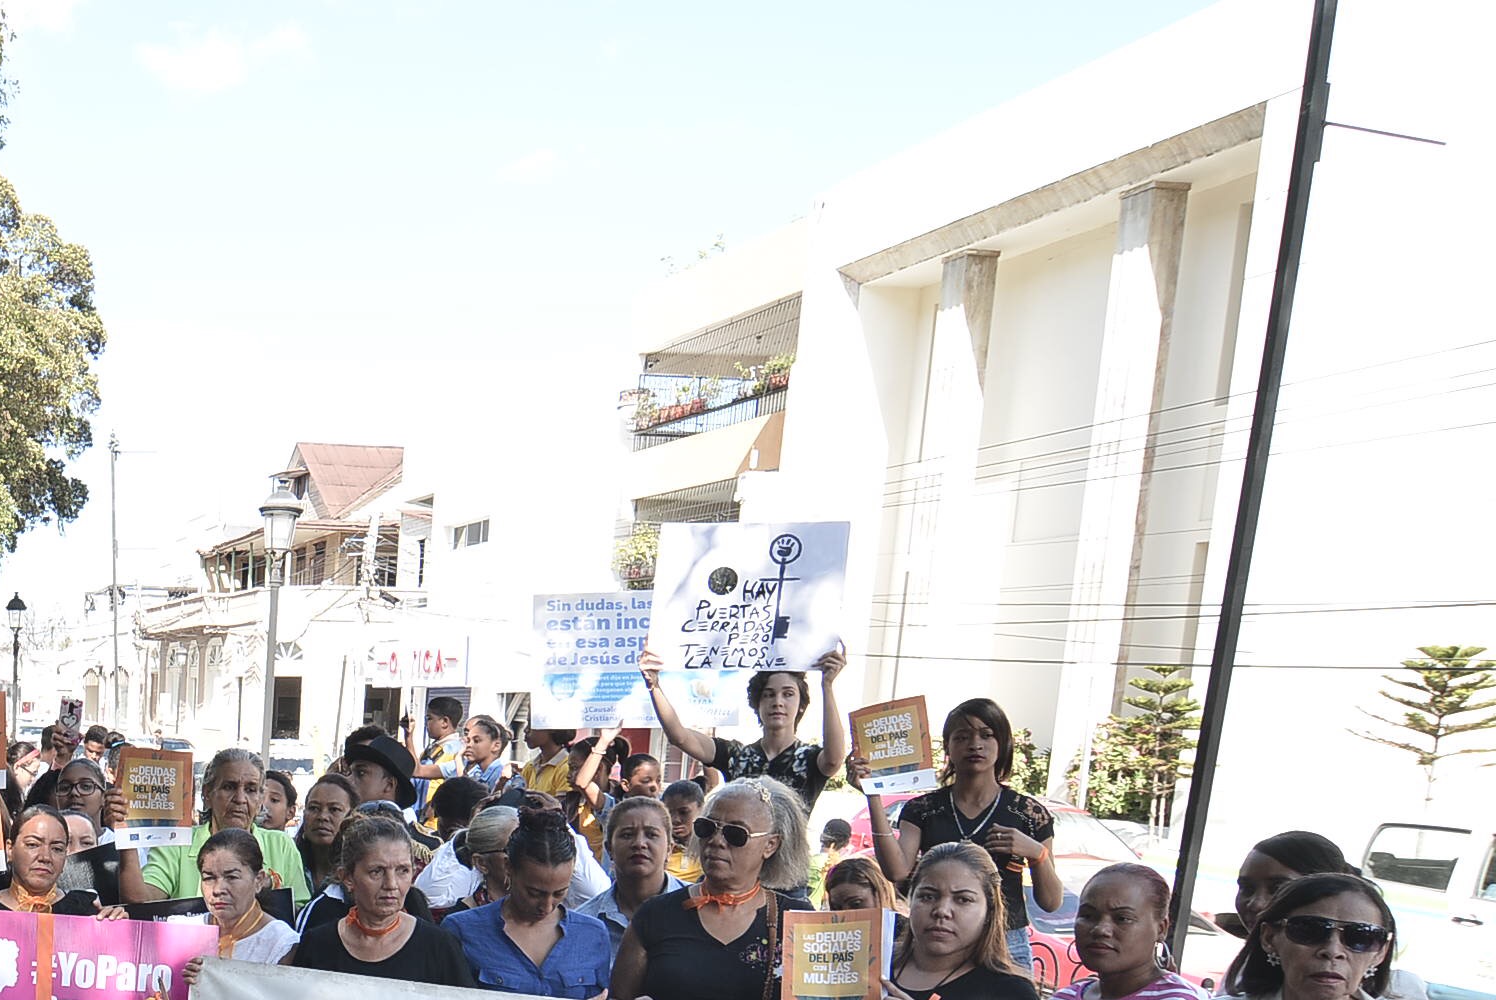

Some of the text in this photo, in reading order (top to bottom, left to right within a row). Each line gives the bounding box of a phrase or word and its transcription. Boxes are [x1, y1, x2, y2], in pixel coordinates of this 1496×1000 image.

[743, 580, 777, 604] HAY
[547, 598, 628, 612] Sin dudas,
[696, 600, 773, 621] PUERTAS
[546, 613, 610, 631] están
[681, 620, 773, 633] CERRADAS
[727, 633, 769, 645] PERO
[680, 644, 769, 659] TENEMOS
[571, 651, 620, 666] Jesús
[684, 656, 787, 669] LA LLAVE
[815, 929, 862, 943] DEUDAS
[802, 940, 861, 953] SOCIALES
[809, 950, 854, 963] DEL PAÍS
[828, 961, 851, 973] LAS
[803, 972, 859, 985] MUJERES
